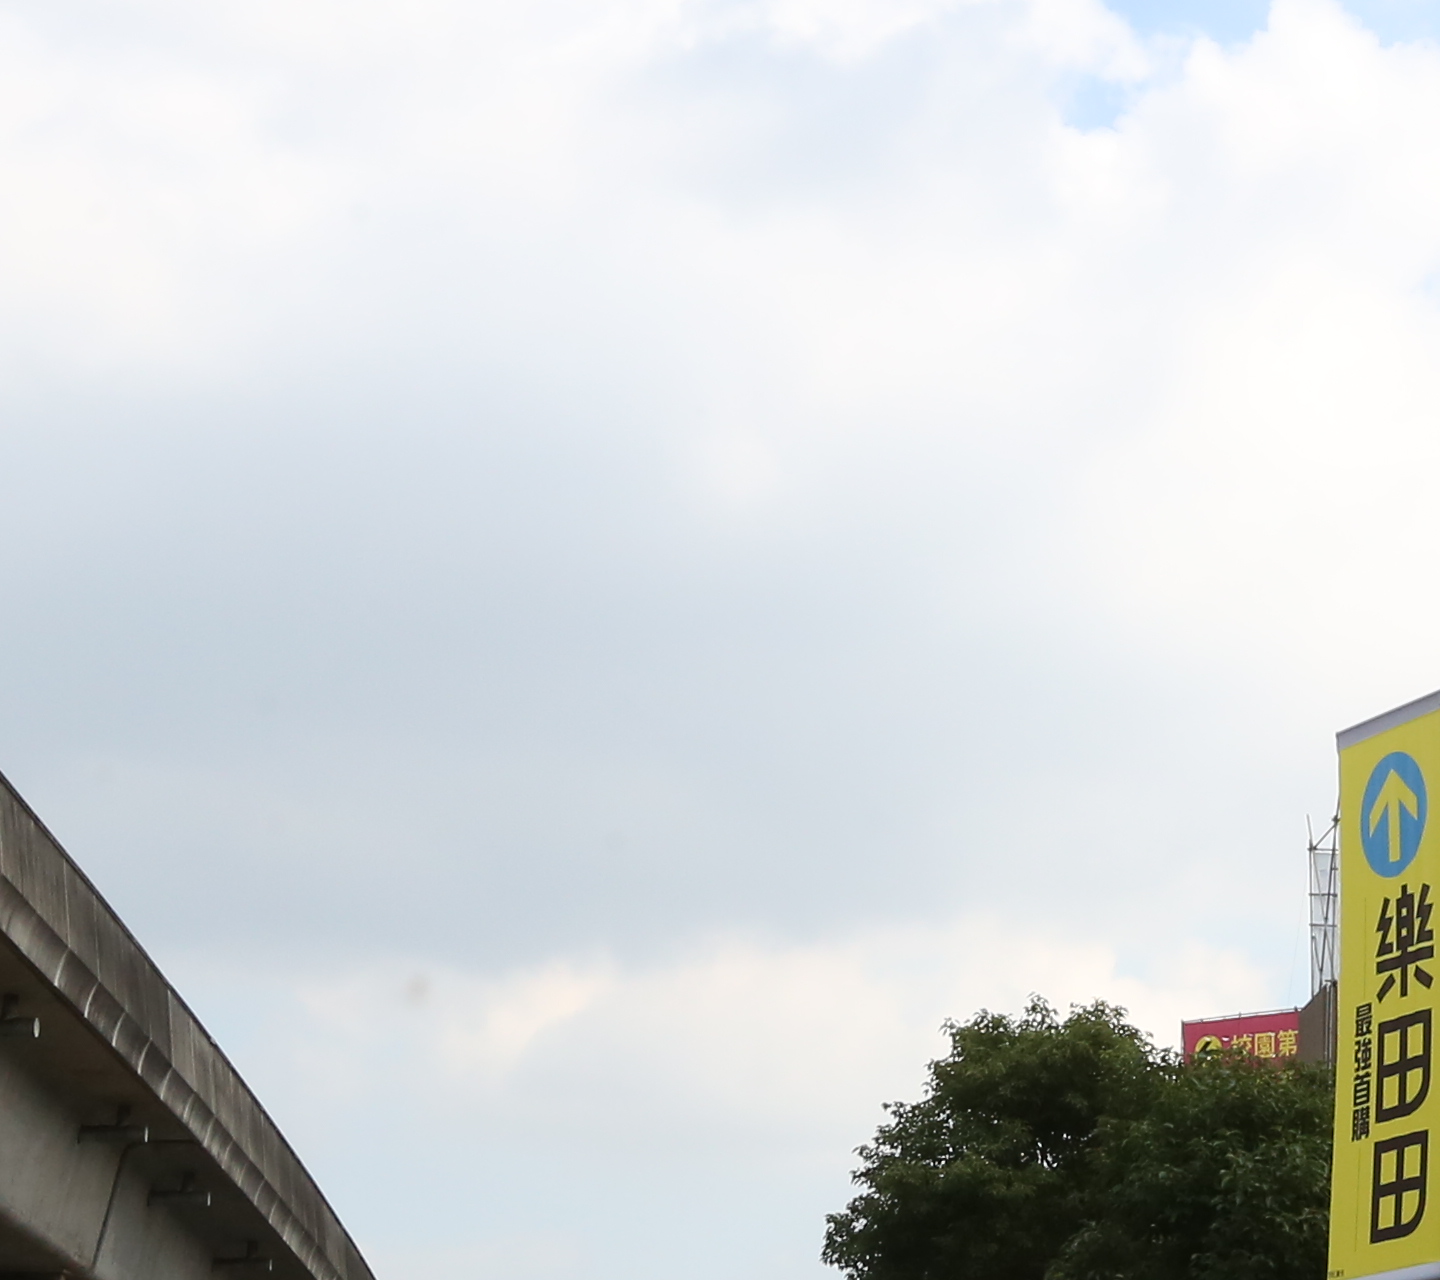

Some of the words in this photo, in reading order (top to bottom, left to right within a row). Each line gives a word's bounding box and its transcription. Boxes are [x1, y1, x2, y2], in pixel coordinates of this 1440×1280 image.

[1351, 1003, 1372, 1142] 最強首購
[1370, 883, 1435, 1245] 樂田田
